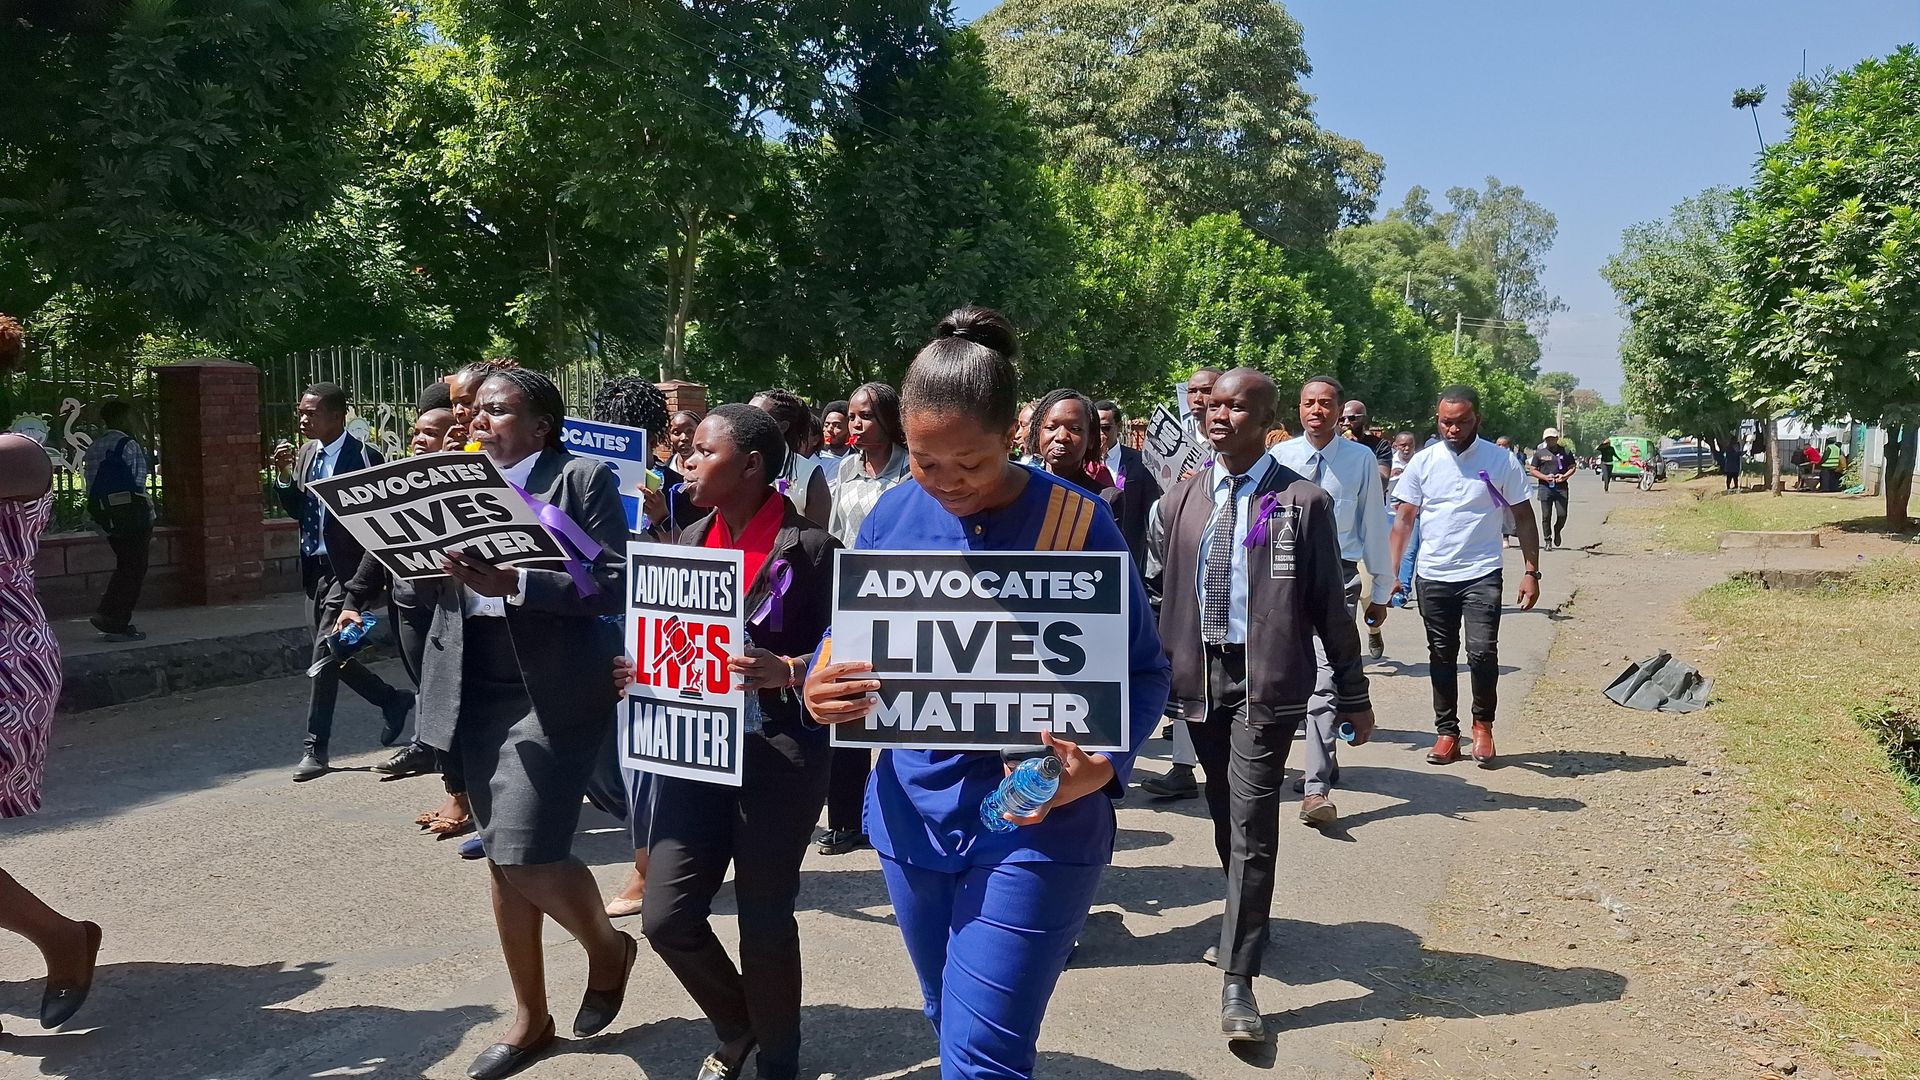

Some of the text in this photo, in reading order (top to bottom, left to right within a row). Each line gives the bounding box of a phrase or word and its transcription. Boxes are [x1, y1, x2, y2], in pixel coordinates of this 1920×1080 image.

[560, 427, 630, 452] OCATES'
[336, 463, 488, 507] ADVOCATES'
[364, 492, 514, 546] LIVES
[635, 564, 735, 612] ADVOCATES'
[857, 570, 1103, 600] ADVOCATES'
[636, 616, 731, 694] LIVES
[871, 619, 1086, 676] LIVES
[633, 702, 729, 768] MATTER
[865, 691, 1090, 734] MATTER
